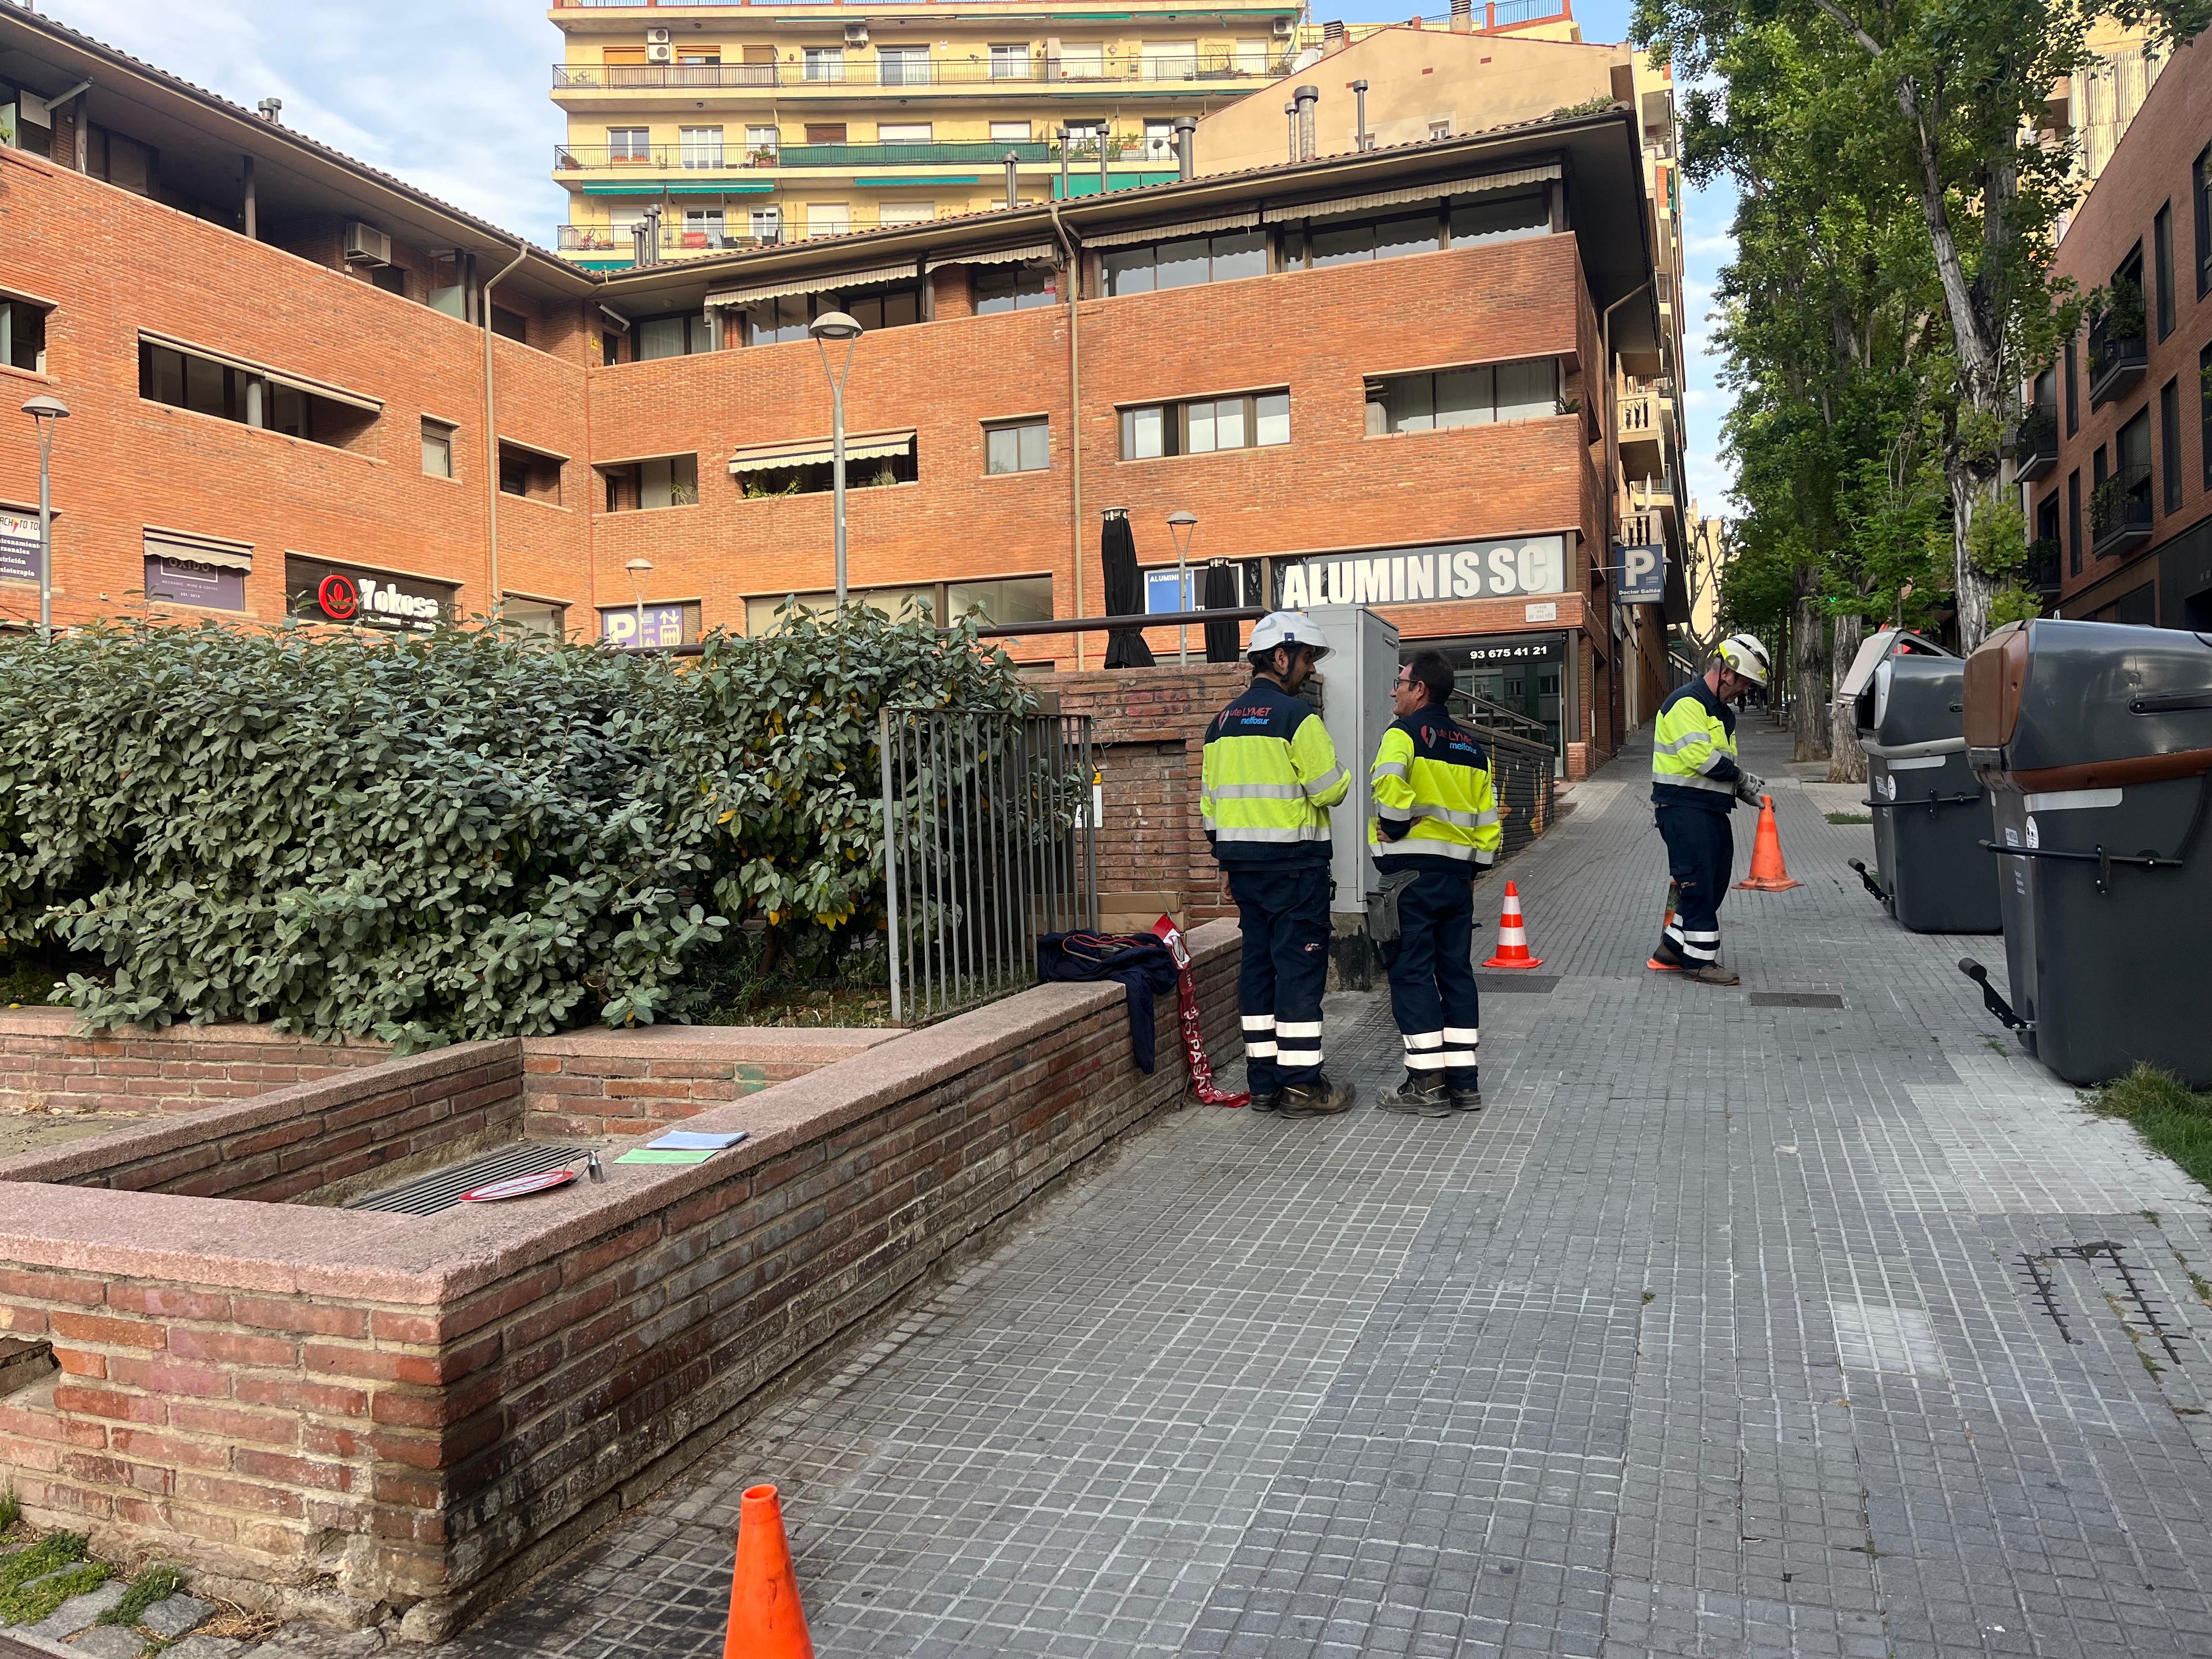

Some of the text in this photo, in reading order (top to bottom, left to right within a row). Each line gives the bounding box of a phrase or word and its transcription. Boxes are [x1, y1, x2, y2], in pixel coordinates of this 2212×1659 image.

[20, 520, 27, 529] TO
[31, 521, 40, 531] TO
[1625, 549, 1655, 587] P
[1149, 573, 1189, 583] ALUMINIR
[1282, 545, 1547, 609] ALUMINIS SC
[608, 614, 636, 645] P
[1470, 646, 1547, 659] 93 675 41 21
[1229, 707, 1272, 716] ute LYMET
